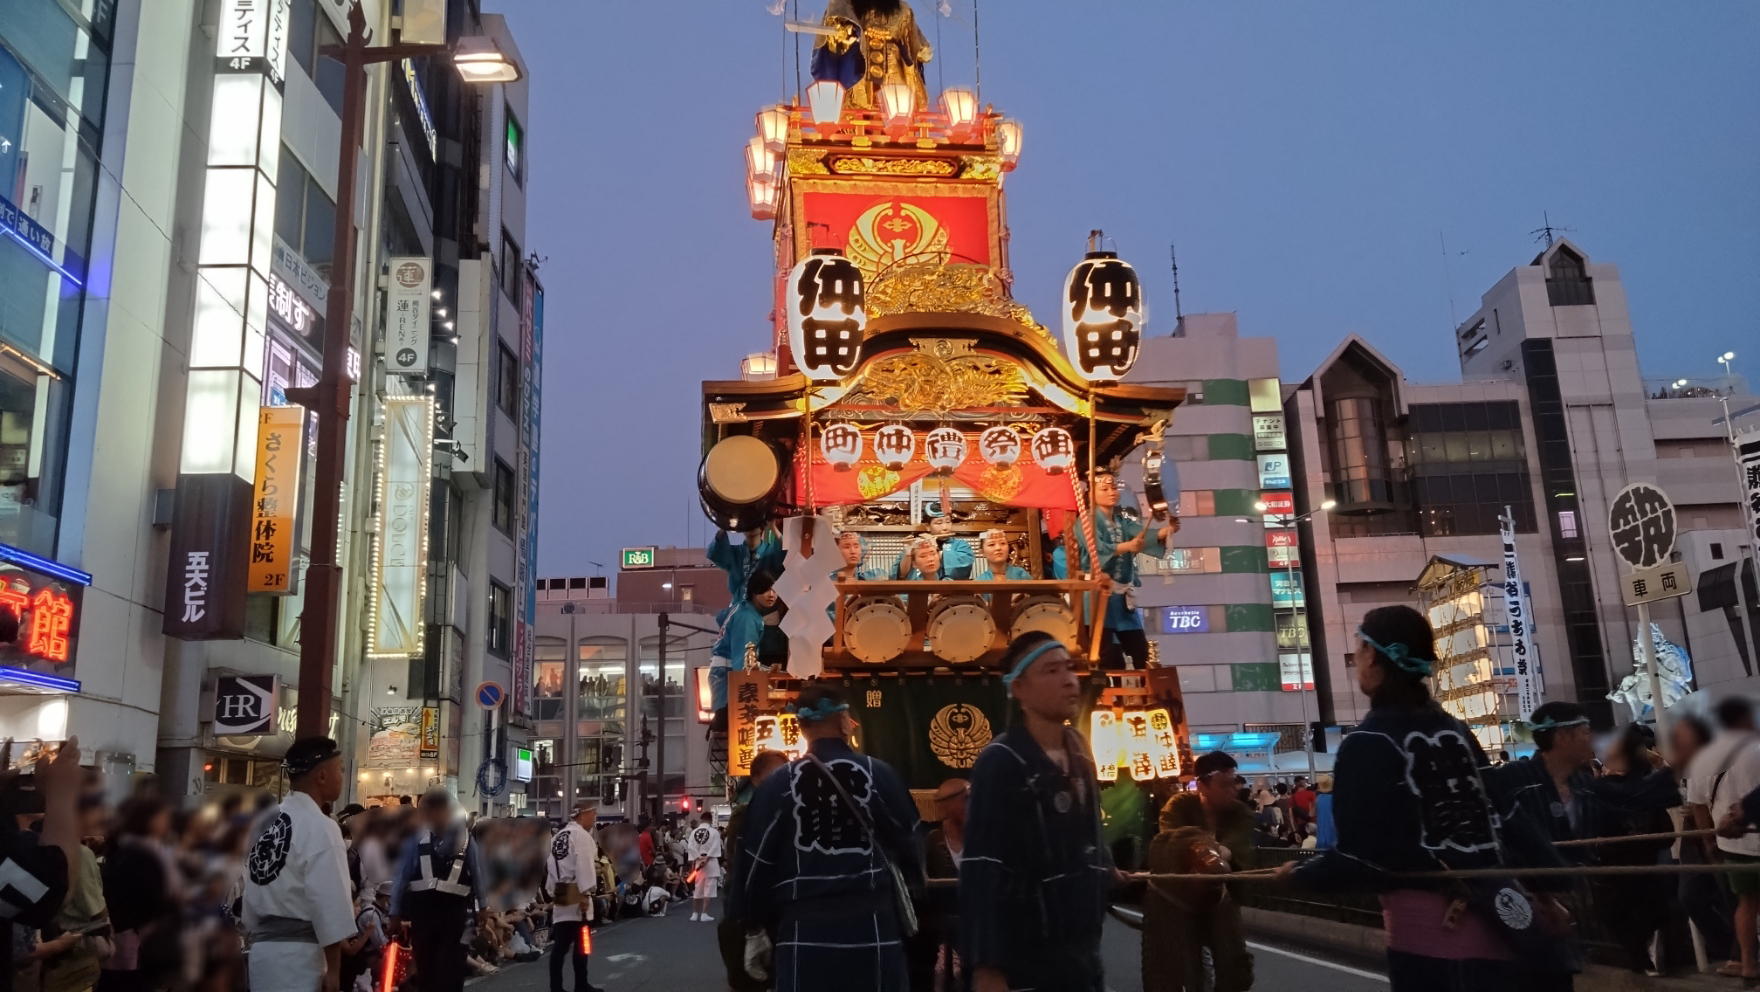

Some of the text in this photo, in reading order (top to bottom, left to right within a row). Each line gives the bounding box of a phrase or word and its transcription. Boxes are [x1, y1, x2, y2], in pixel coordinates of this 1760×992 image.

[231, 0, 255, 52] ティス
[229, 57, 251, 69] 4F
[396, 299, 410, 312] 蓮
[398, 353, 415, 362] 4F
[252, 432, 282, 563] さくら整体院
[182, 551, 209, 622] 五大ビル
[264, 574, 286, 586] 2F
[1632, 571, 1678, 597] 車両
[1170, 616, 1201, 628] TBC
